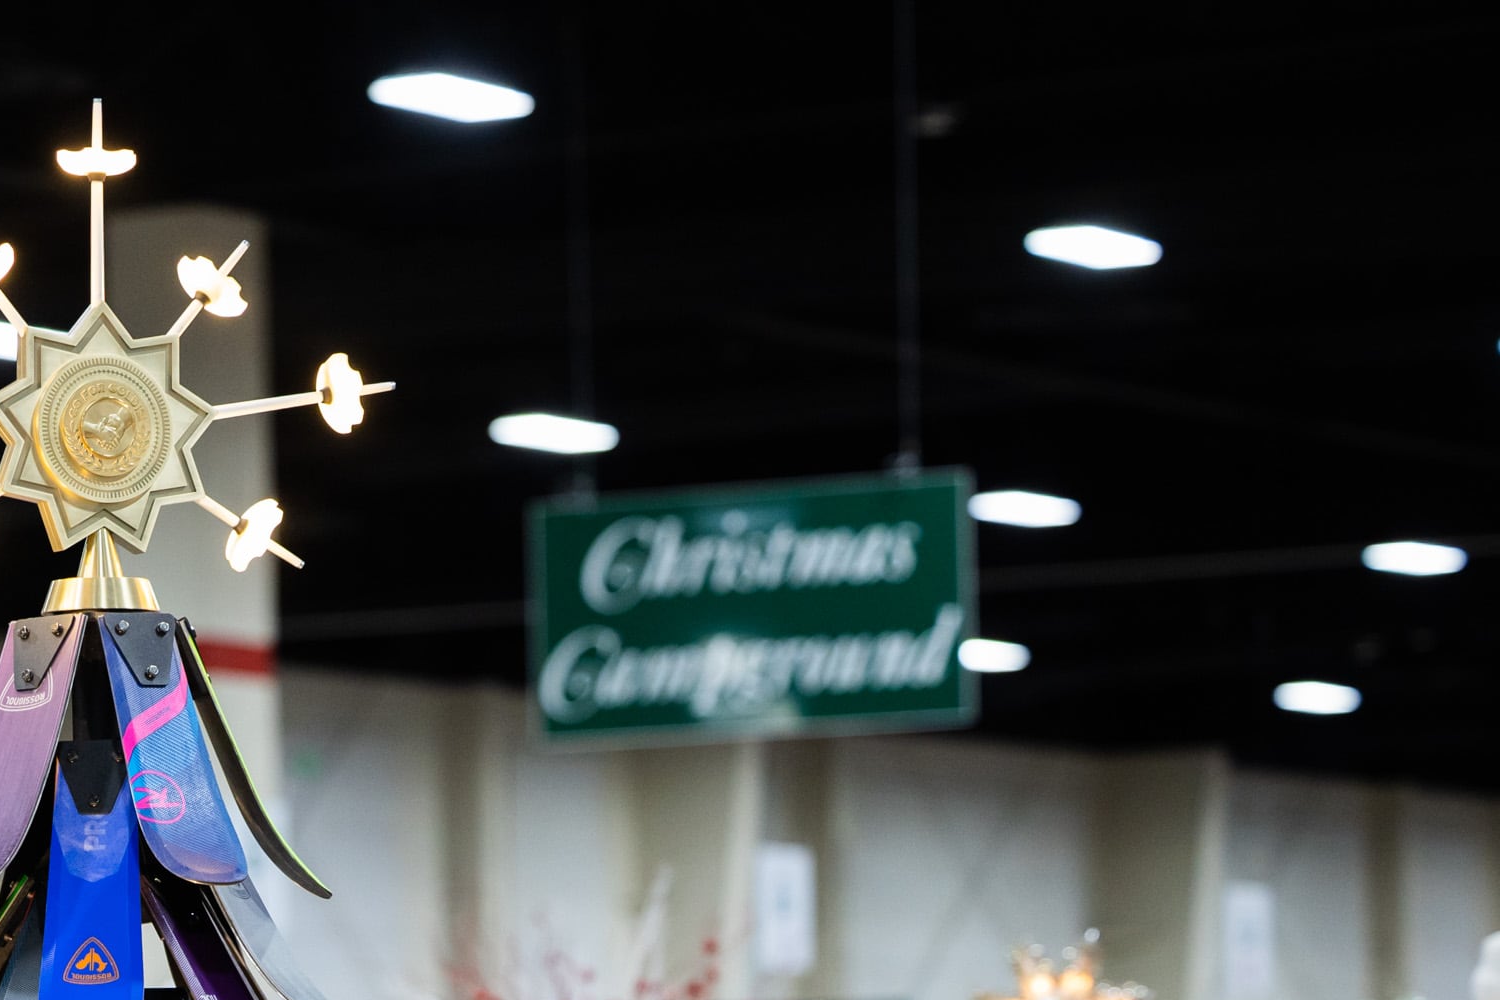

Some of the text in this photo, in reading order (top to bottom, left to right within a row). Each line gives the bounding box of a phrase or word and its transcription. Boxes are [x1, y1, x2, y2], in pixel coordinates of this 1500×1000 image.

[580, 510, 921, 615] Christmas
[539, 603, 963, 723] Campground
[5, 691, 46, 705] ROSSIGNOL
[83, 815, 108, 852] PR
[71, 972, 113, 981] ROSSIGNOL
